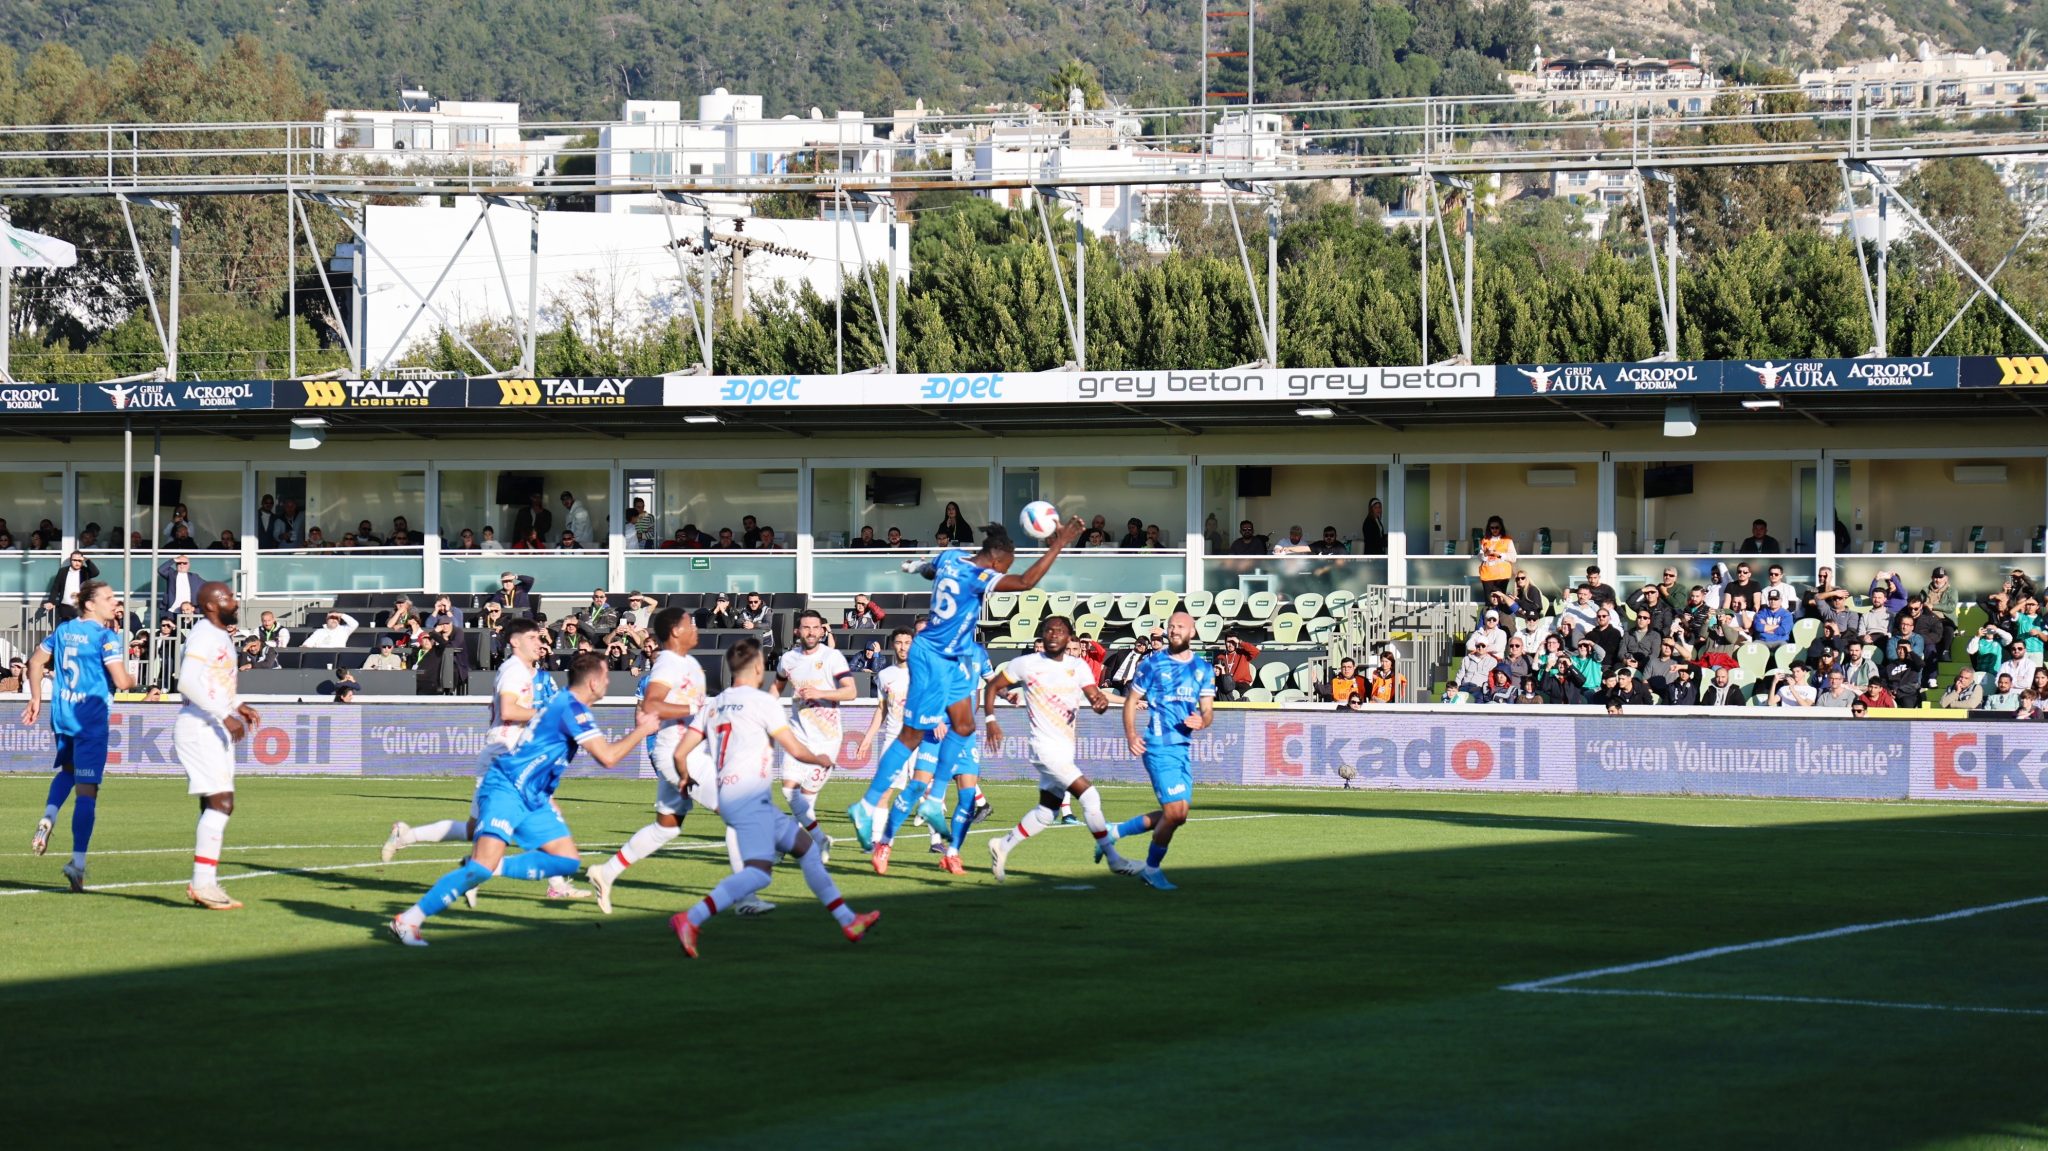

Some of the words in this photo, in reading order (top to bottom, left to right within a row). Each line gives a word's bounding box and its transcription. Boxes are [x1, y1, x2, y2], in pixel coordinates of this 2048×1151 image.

[1565, 367, 1592, 376] GRUP
[1616, 365, 1697, 382] ACROPOL
[1795, 363, 1823, 372] GRUP
[1848, 362, 1933, 378] ACROPOL
[1079, 377, 1156, 399] grey
[1168, 372, 1264, 392] beton
[1288, 374, 1369, 396] grey
[1381, 369, 1481, 389] beton
[1552, 375, 1607, 391] AURA
[1635, 381, 1677, 390] BODRUM
[1780, 371, 1838, 387] AURA
[1868, 377, 1912, 386] BODRUM
[0, 388, 59, 401] CROPOL
[140, 385, 163, 393] GRUP
[183, 384, 253, 399] ACROPOL
[346, 381, 437, 397] TALAY
[541, 379, 633, 396] TALAY
[720, 376, 801, 404] opet
[920, 374, 1004, 402] opet
[7, 401, 42, 409] BODRUM
[128, 393, 176, 407] AURA
[200, 398, 236, 406] BODRUM
[351, 398, 429, 406] LOGISTICS
[547, 397, 625, 405] LOGISTICS
[62, 646, 80, 689] 5
[128, 714, 331, 765] koil
[716, 721, 733, 771] 7
[1310, 724, 1540, 780] kadoil
[1586, 739, 1668, 771] “Güven
[1674, 741, 1788, 773] Yolunuzun
[1795, 737, 1903, 775] Üstünde”
